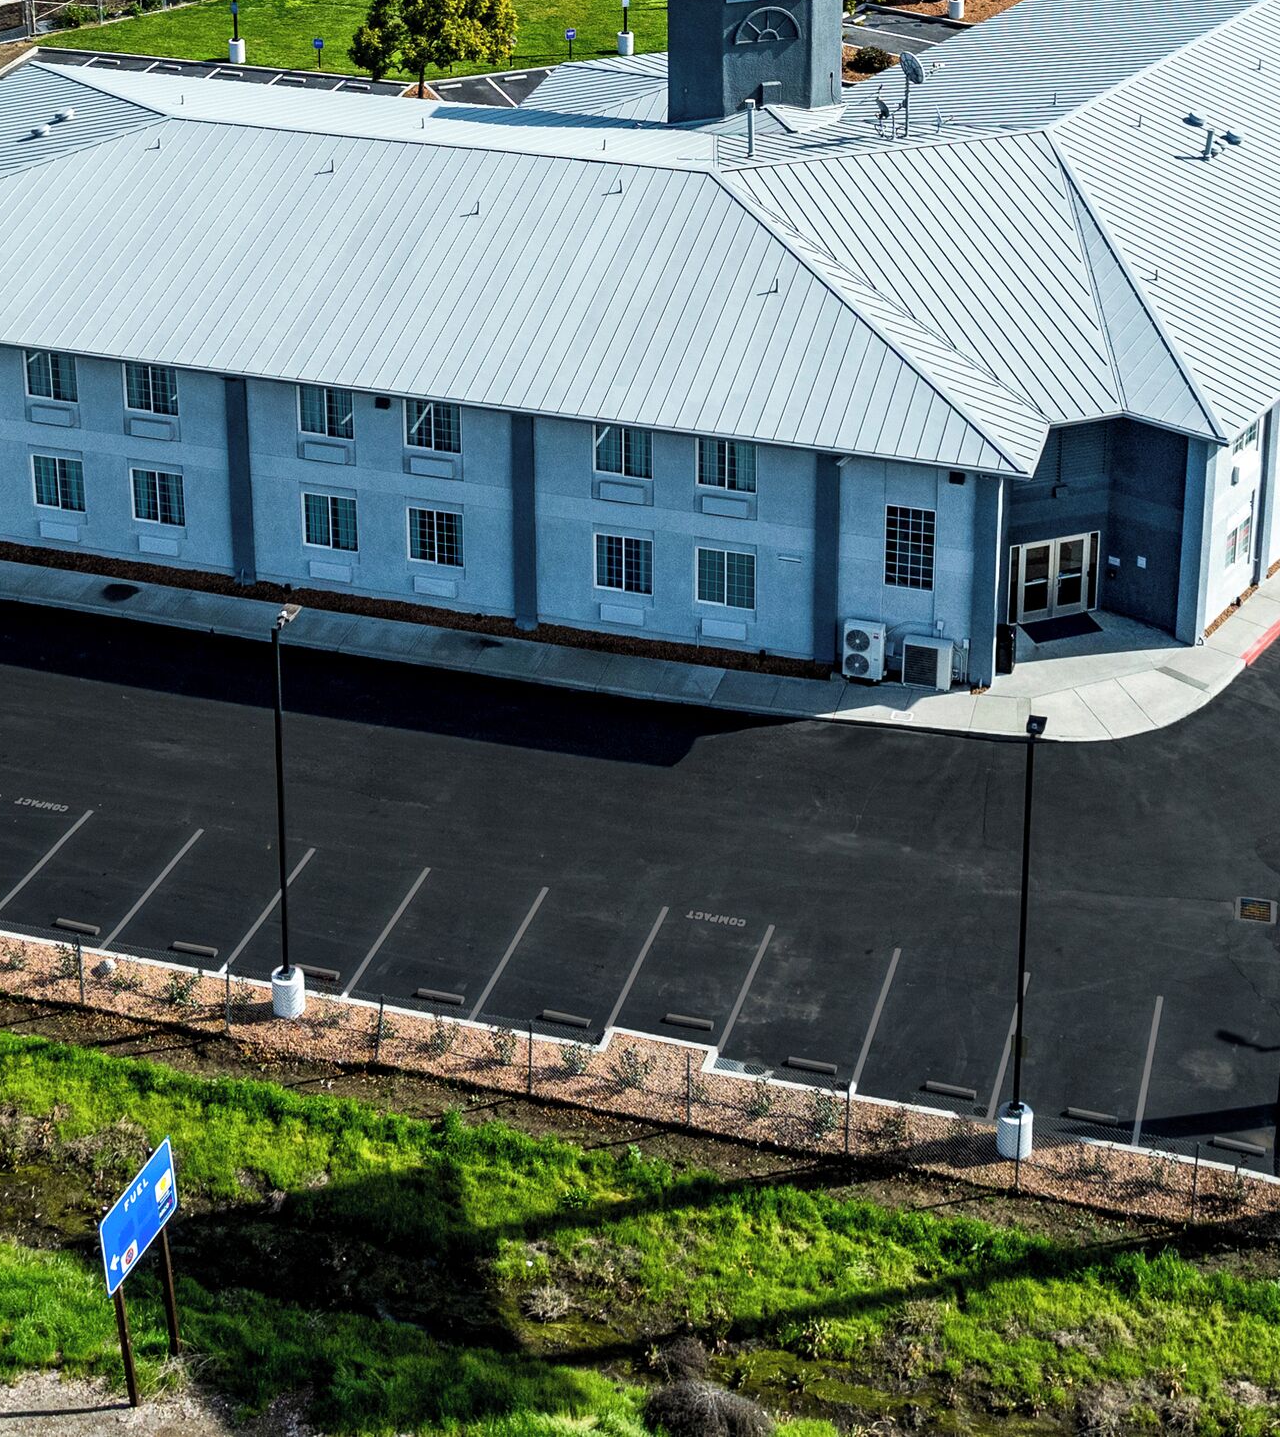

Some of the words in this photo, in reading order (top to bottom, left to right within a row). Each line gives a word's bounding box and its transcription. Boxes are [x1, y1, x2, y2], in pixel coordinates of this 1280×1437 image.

[14, 797, 69, 812] COMPACT
[685, 910, 747, 927] COMPACT
[123, 1178, 149, 1213] FUEL
